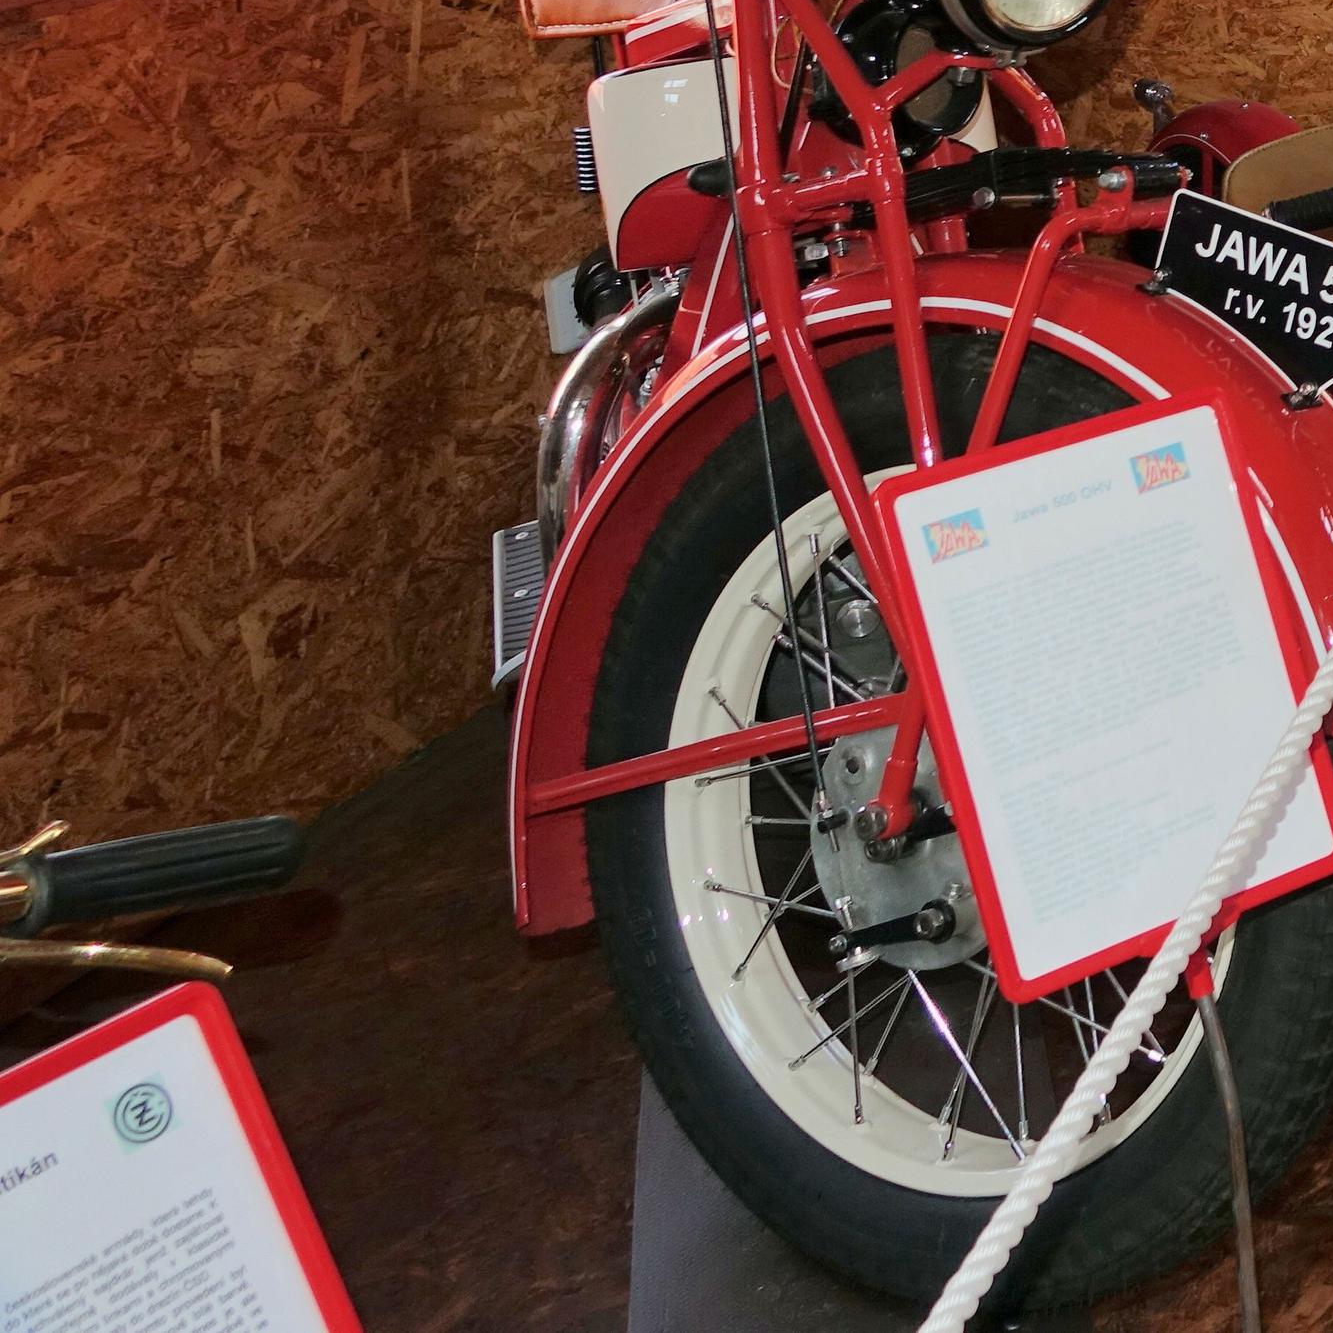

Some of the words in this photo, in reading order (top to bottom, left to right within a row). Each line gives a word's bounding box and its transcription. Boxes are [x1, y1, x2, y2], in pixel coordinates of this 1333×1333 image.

[1195, 223, 1310, 296] JAWA
[1224, 285, 1267, 325] r.v.
[0, 1150, 59, 1197] tikán
